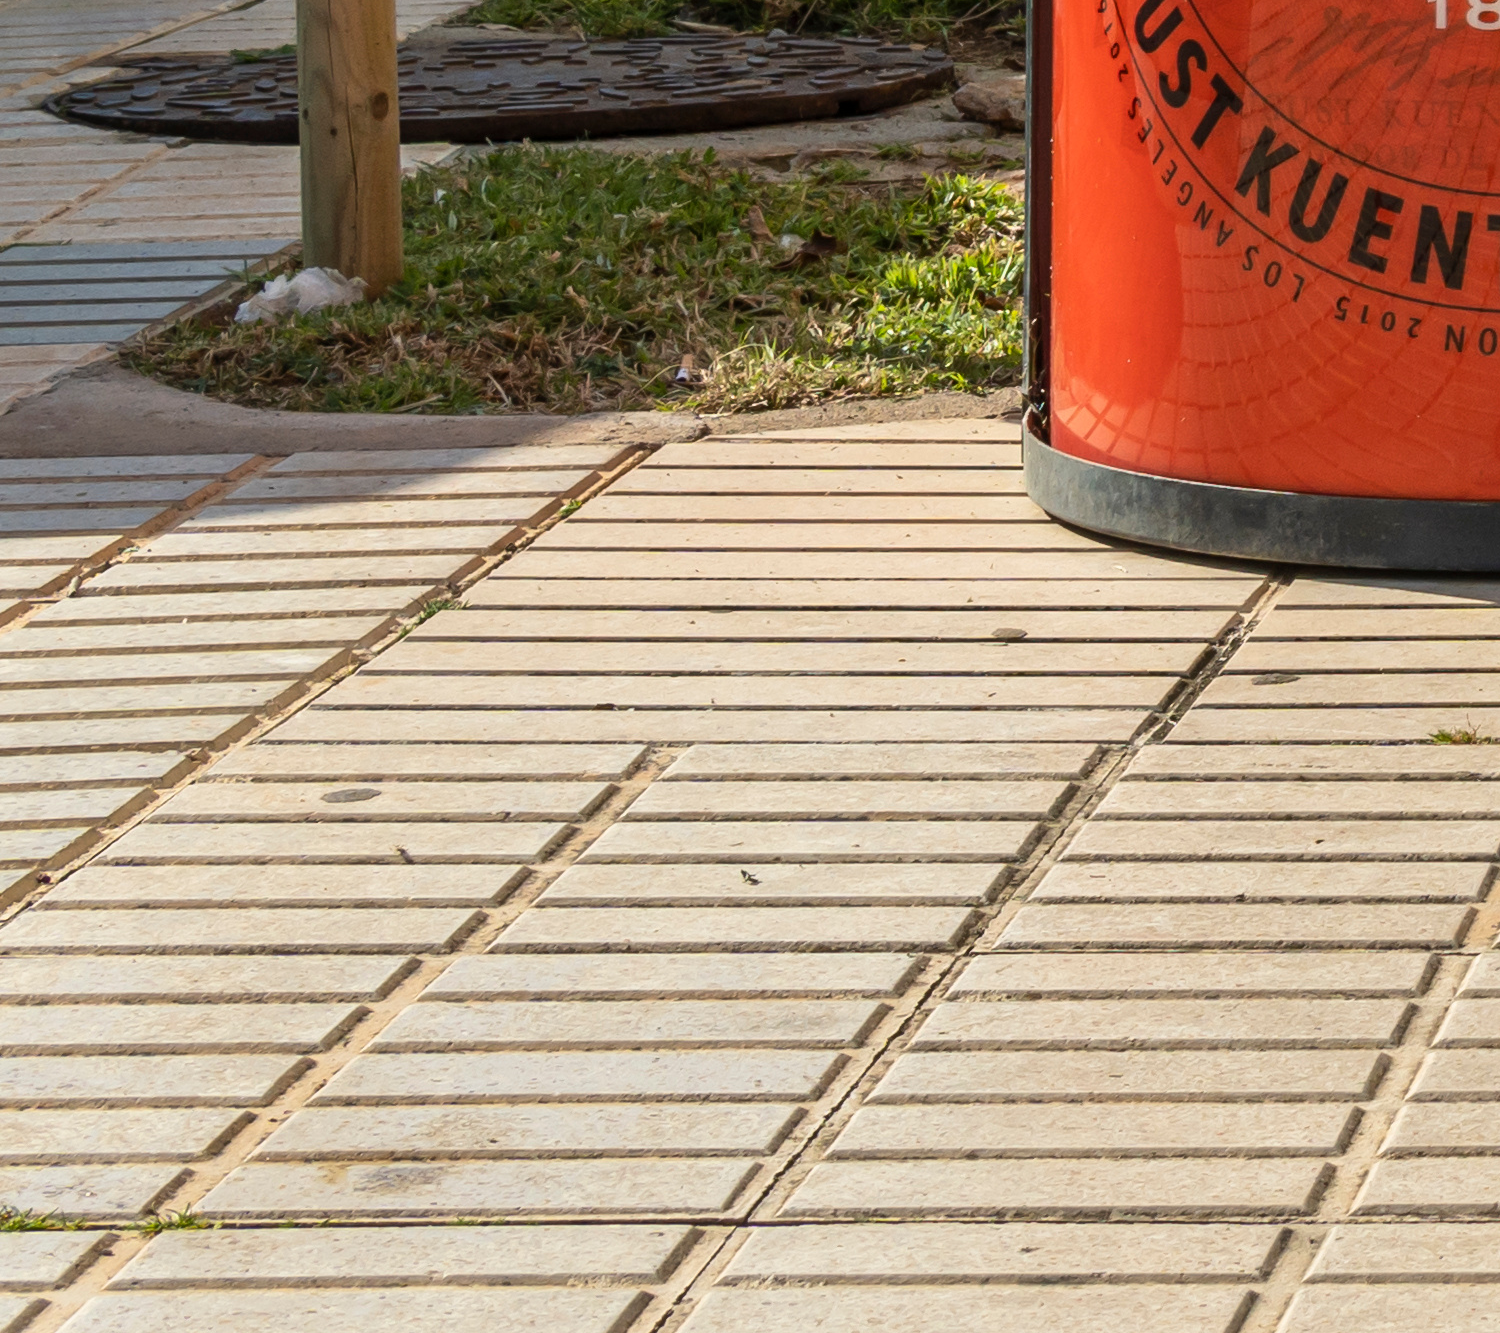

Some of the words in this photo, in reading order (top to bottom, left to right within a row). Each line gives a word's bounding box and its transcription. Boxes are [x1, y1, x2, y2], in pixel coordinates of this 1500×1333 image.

[1127, 95, 1235, 249] ANGELES
[1241, 243, 1306, 303] LOS
[1333, 294, 1423, 339] 2015
